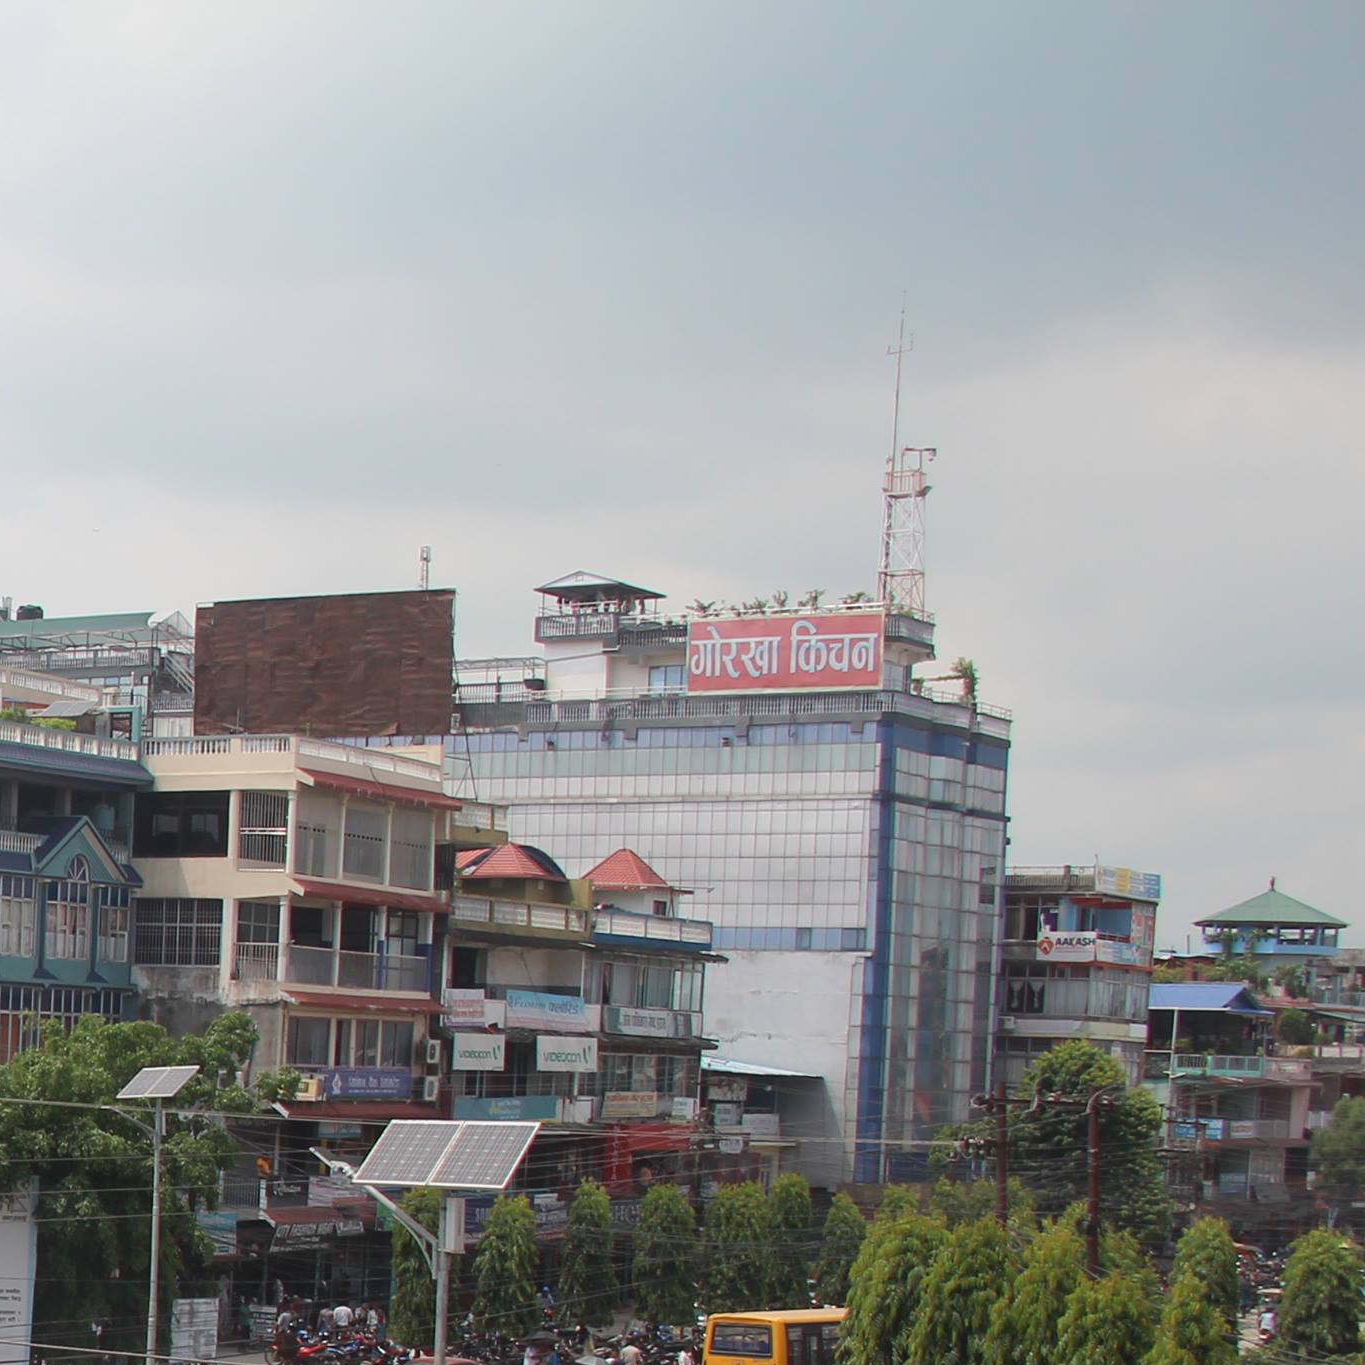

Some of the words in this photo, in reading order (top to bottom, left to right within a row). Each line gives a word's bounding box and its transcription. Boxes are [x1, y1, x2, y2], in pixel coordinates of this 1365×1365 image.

[690, 626, 781, 678] गोरखा
[789, 620, 878, 674] किचन
[1055, 937, 1095, 948] AAKASH
